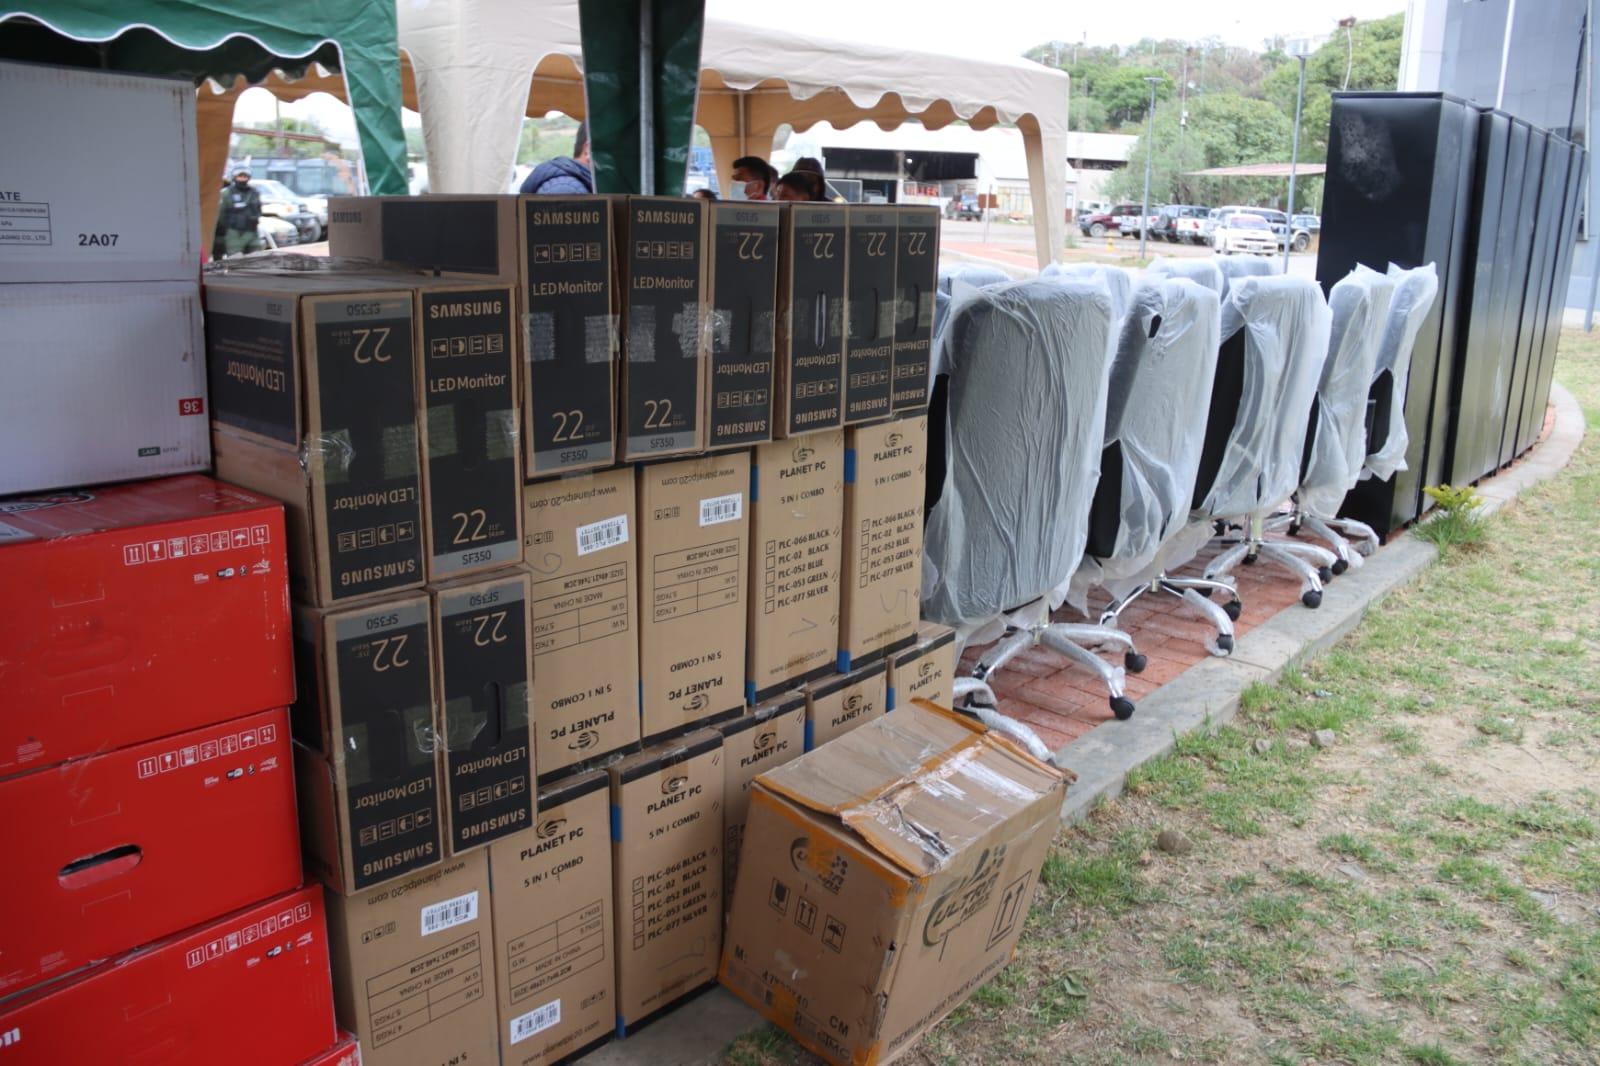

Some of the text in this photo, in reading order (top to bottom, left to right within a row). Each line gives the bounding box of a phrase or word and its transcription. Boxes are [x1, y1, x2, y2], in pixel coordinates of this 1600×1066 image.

[534, 211, 600, 225] SAMSUNG
[638, 210, 694, 224] SAMSUNG
[78, 234, 119, 246] 2A07
[738, 232, 764, 260] 22
[813, 232, 834, 258] 22
[867, 232, 887, 256] 22
[908, 232, 927, 256] 22
[533, 280, 604, 296] LED Monitor
[633, 276, 696, 289] LED Monitor
[430, 301, 502, 318] SAMSUNG
[352, 327, 392, 364] 22
[226, 360, 286, 393] LED Monitor
[716, 362, 770, 376] LED Monitor
[430, 372, 506, 393] LED Monitor
[644, 399, 672, 429] 22
[850, 397, 888, 412] SAMSUNG
[552, 410, 584, 442] 22
[795, 408, 838, 424] SAMSUNG
[716, 420, 766, 436] SAMSUNG
[650, 436, 675, 449] SF350
[873, 444, 912, 462] PLANET PC
[560, 448, 588, 464] SF350
[780, 460, 826, 479] PLANET PC
[890, 470, 912, 482] COMBO
[332, 486, 414, 510] LED Monitor
[780, 496, 786, 504] 5
[786, 494, 794, 503] IN
[800, 487, 825, 500] COMBO
[898, 508, 915, 520] BLACK
[452, 508, 488, 544] 22
[896, 522, 914, 534] BLACK
[778, 528, 830, 550] PLC-066 BLACK
[896, 536, 910, 548] BLUE
[462, 550, 492, 566] SF350
[778, 543, 830, 565] PLC-02 BLACK
[895, 548, 914, 560] GREEN
[340, 558, 416, 586] SAMSUNG
[778, 558, 824, 579] PLC-052 BLUE
[894, 560, 914, 574] SILVER
[778, 570, 828, 593] PLC-053 GREEN
[470, 591, 500, 607] SF350
[554, 598, 574, 610] CHINA
[584, 592, 604, 603] MADE
[777, 584, 829, 608] PLC-077 SILVER
[366, 614, 400, 630] SF350
[473, 610, 507, 646] 22
[370, 634, 409, 672] 22
[708, 653, 716, 662] IN
[670, 658, 700, 672] COMBO
[606, 684, 612, 692] 5
[668, 676, 723, 700] PLANET PC
[910, 669, 942, 692] PLANET PC
[551, 692, 585, 710] COMBO
[595, 686, 604, 697] IN
[550, 711, 615, 740] PLANET PC
[832, 702, 873, 728] PLANET PC
[456, 746, 526, 776] LED Monitor
[740, 740, 788, 768] PLANET PC
[354, 776, 432, 810] LED Monitor
[647, 784, 702, 814] PLANET PC
[462, 808, 526, 840] SAMSUNG
[649, 831, 654, 840] 5
[656, 826, 664, 836] IN
[672, 810, 700, 829] COMBO
[520, 826, 584, 861] PLANET PC
[363, 842, 433, 876] SAMSUNG
[648, 850, 707, 884] PLC-066 BLACK
[524, 880, 530, 888] 5
[532, 874, 542, 884] IN
[551, 856, 584, 876] COMBO
[648, 864, 707, 898] PLC-02 BLACK
[648, 880, 701, 912] PLC-052 BLUE
[682, 892, 707, 910] GREEN
[648, 904, 708, 941] PLC-077 SILVER
[399, 982, 422, 996] CHINA
[829, 1015, 849, 1038] CM
[461, 1052, 467, 1060] 5
